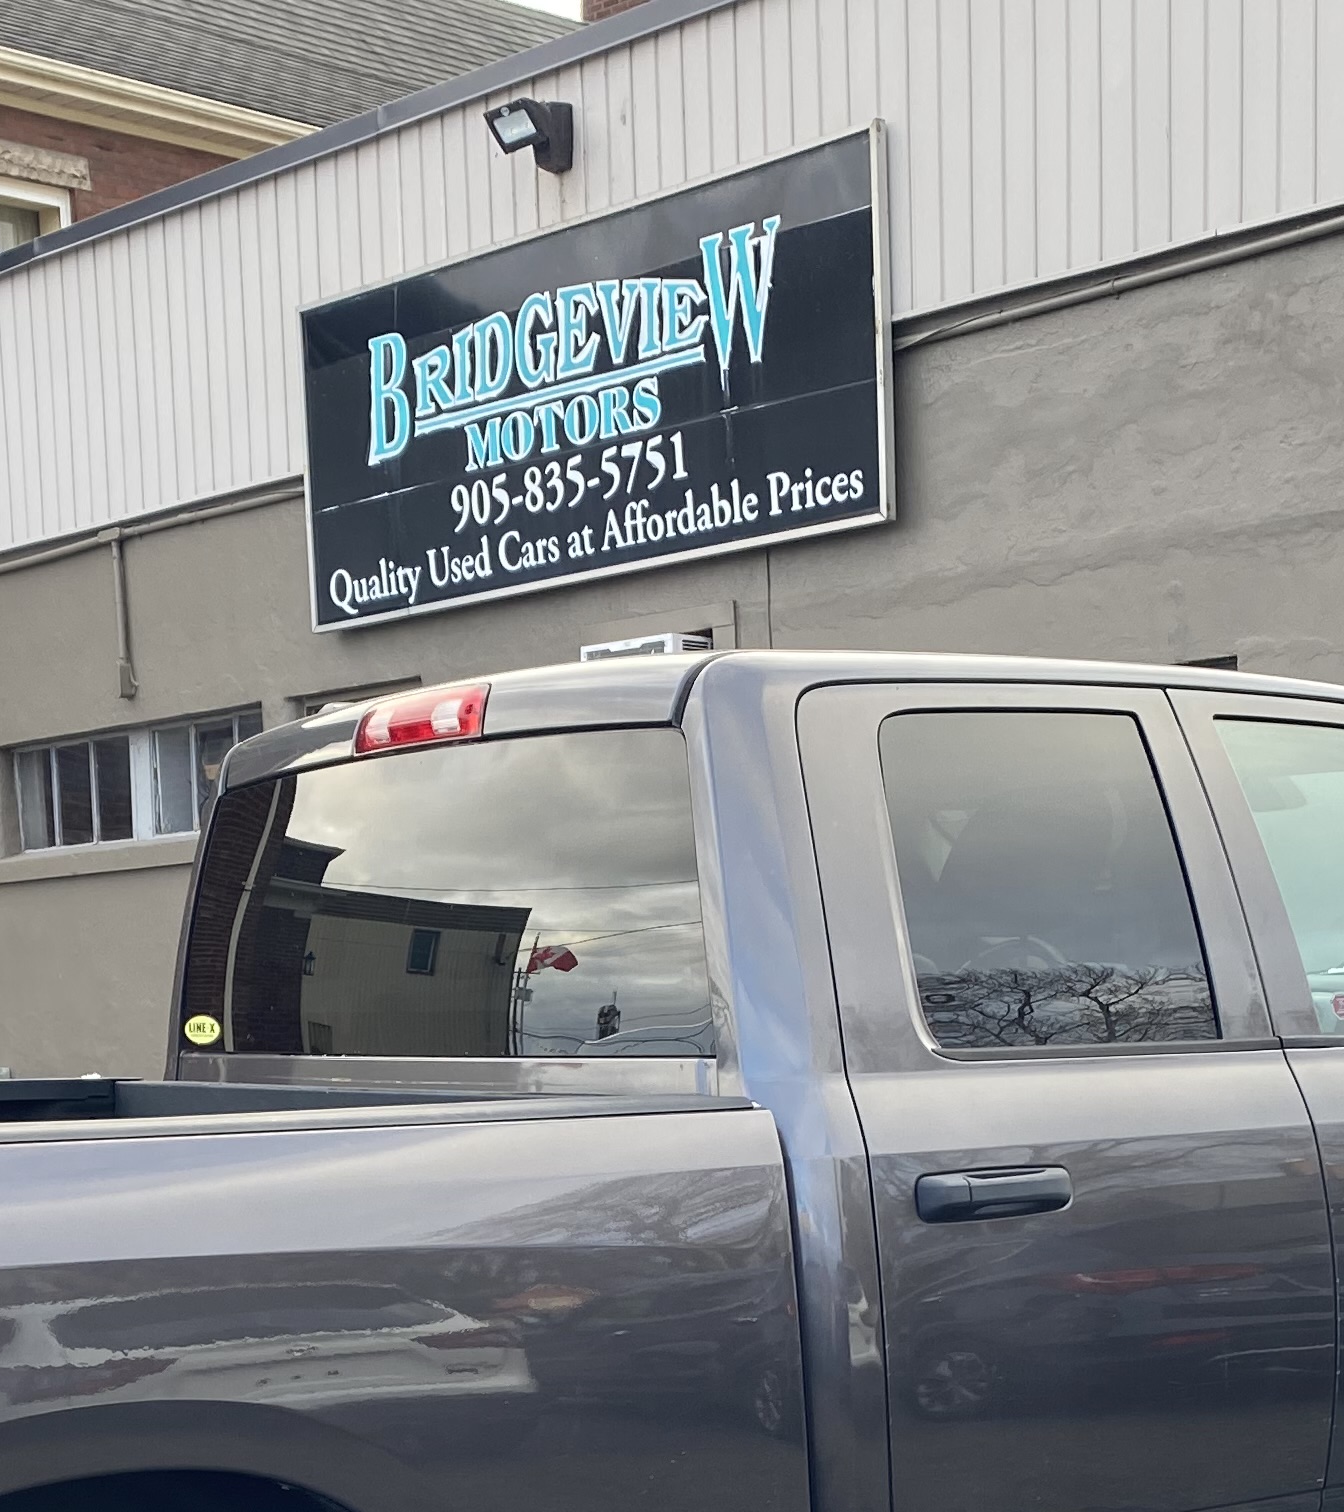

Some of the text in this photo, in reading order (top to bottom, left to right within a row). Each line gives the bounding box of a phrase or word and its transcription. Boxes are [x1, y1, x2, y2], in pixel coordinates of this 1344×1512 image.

[367, 215, 782, 466] BRIDGEVIEW
[451, 430, 689, 533] 905-835-5751
[464, 375, 662, 472] MOTORS
[329, 467, 865, 615] Quality Used Cars at Affordable Prices
